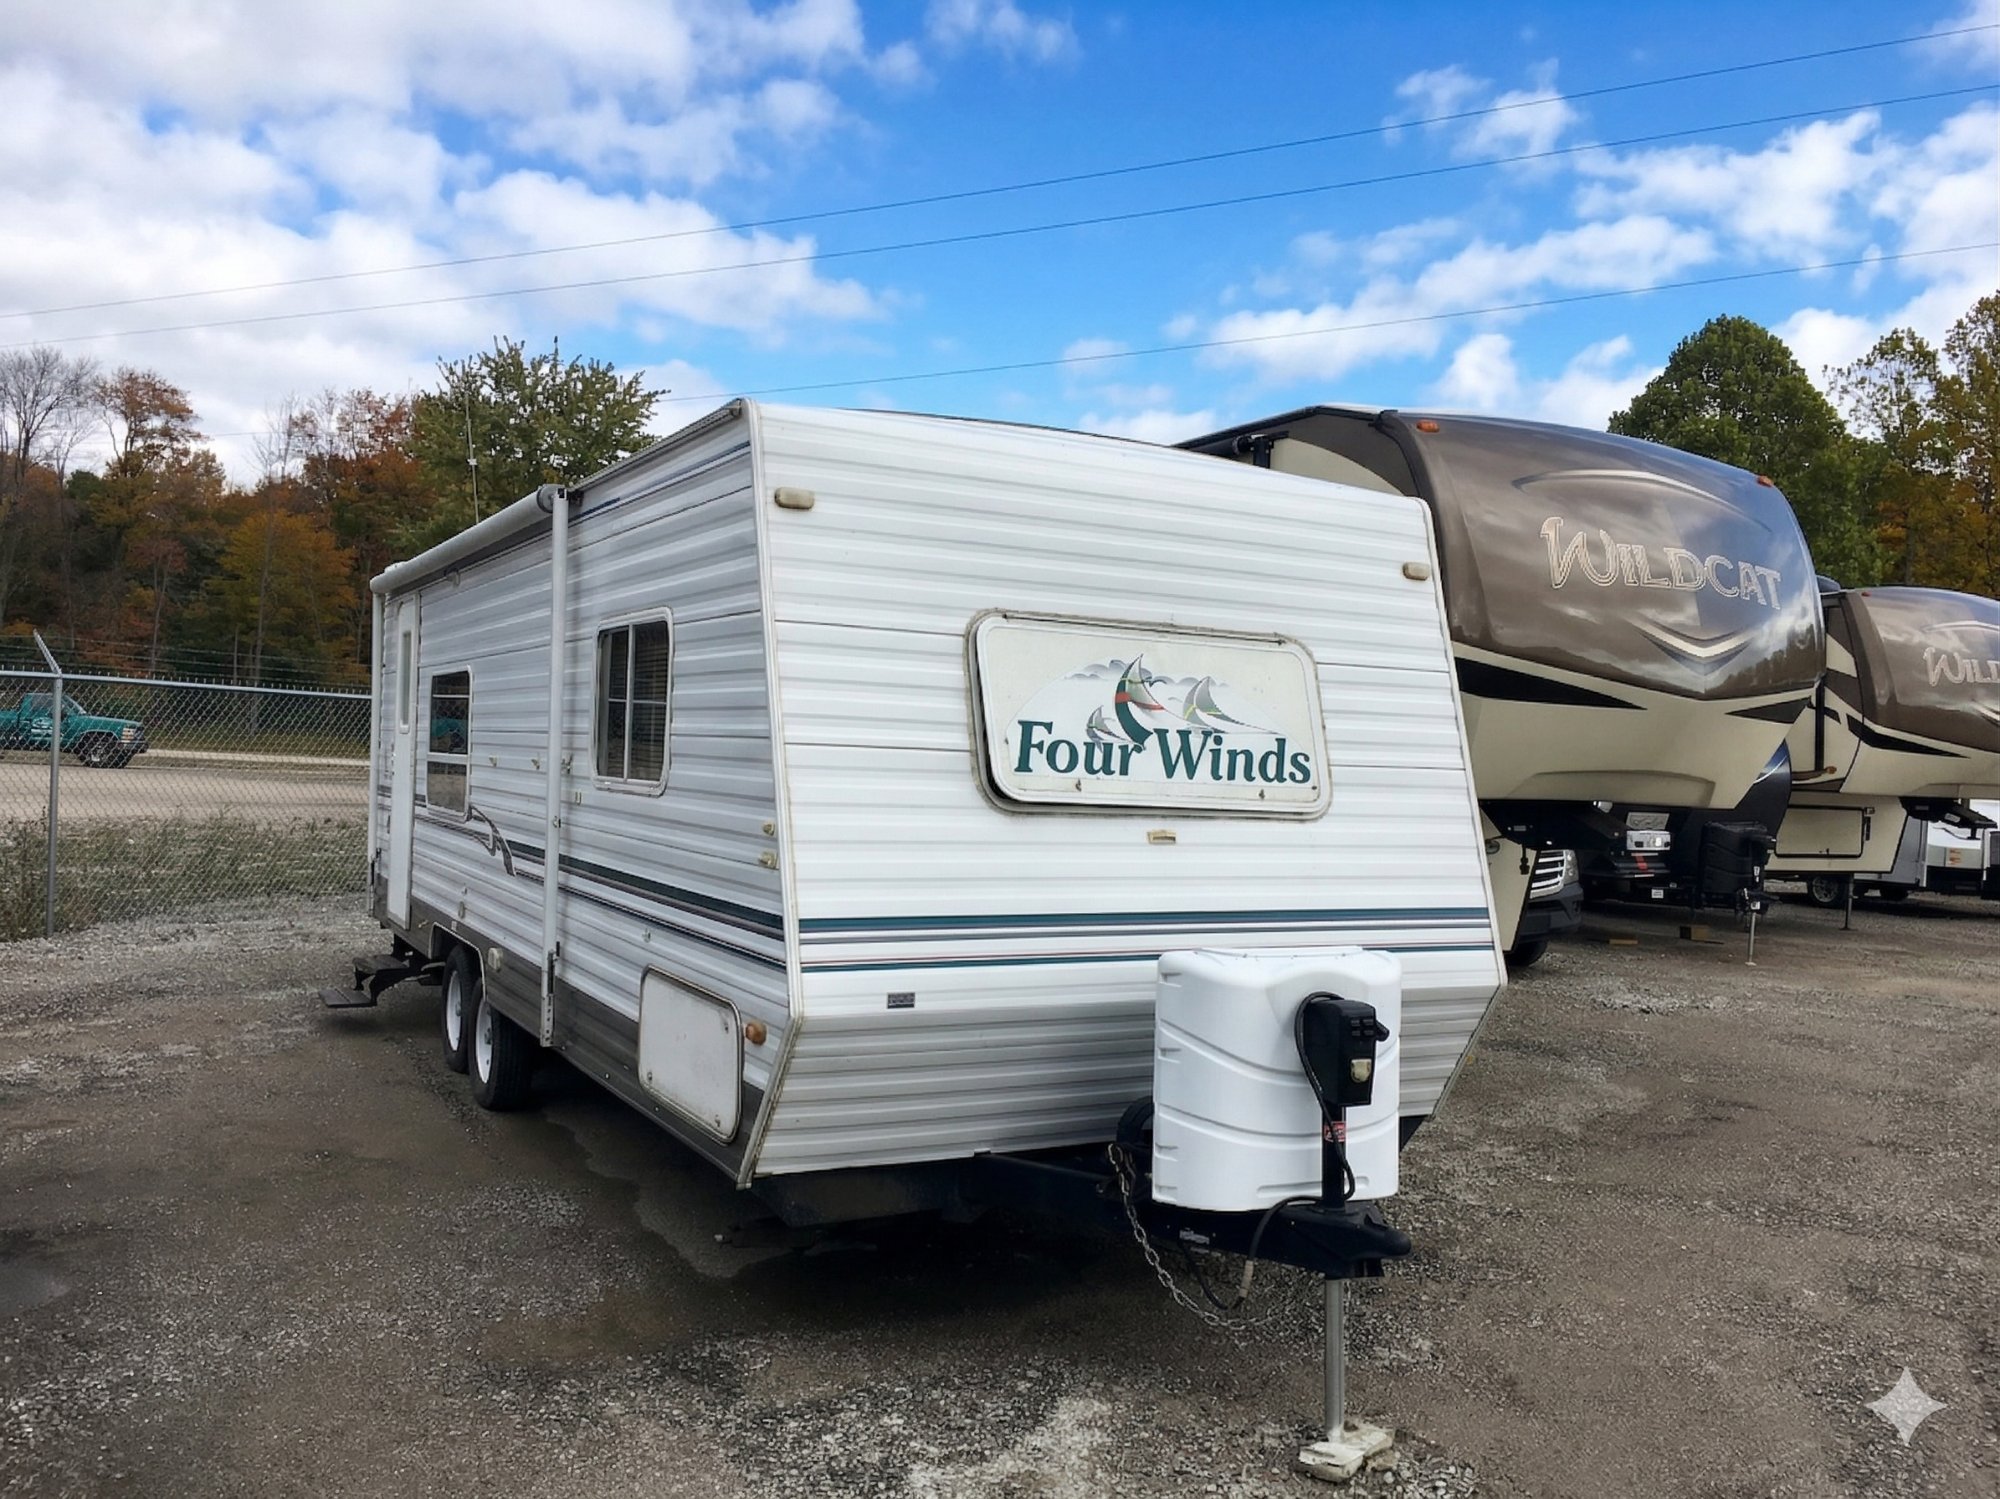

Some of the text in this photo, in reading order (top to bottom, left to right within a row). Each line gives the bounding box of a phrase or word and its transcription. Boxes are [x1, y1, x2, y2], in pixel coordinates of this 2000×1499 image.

[1540, 517, 1781, 609] WILDCAT
[1014, 720, 1311, 784] Four Winds
